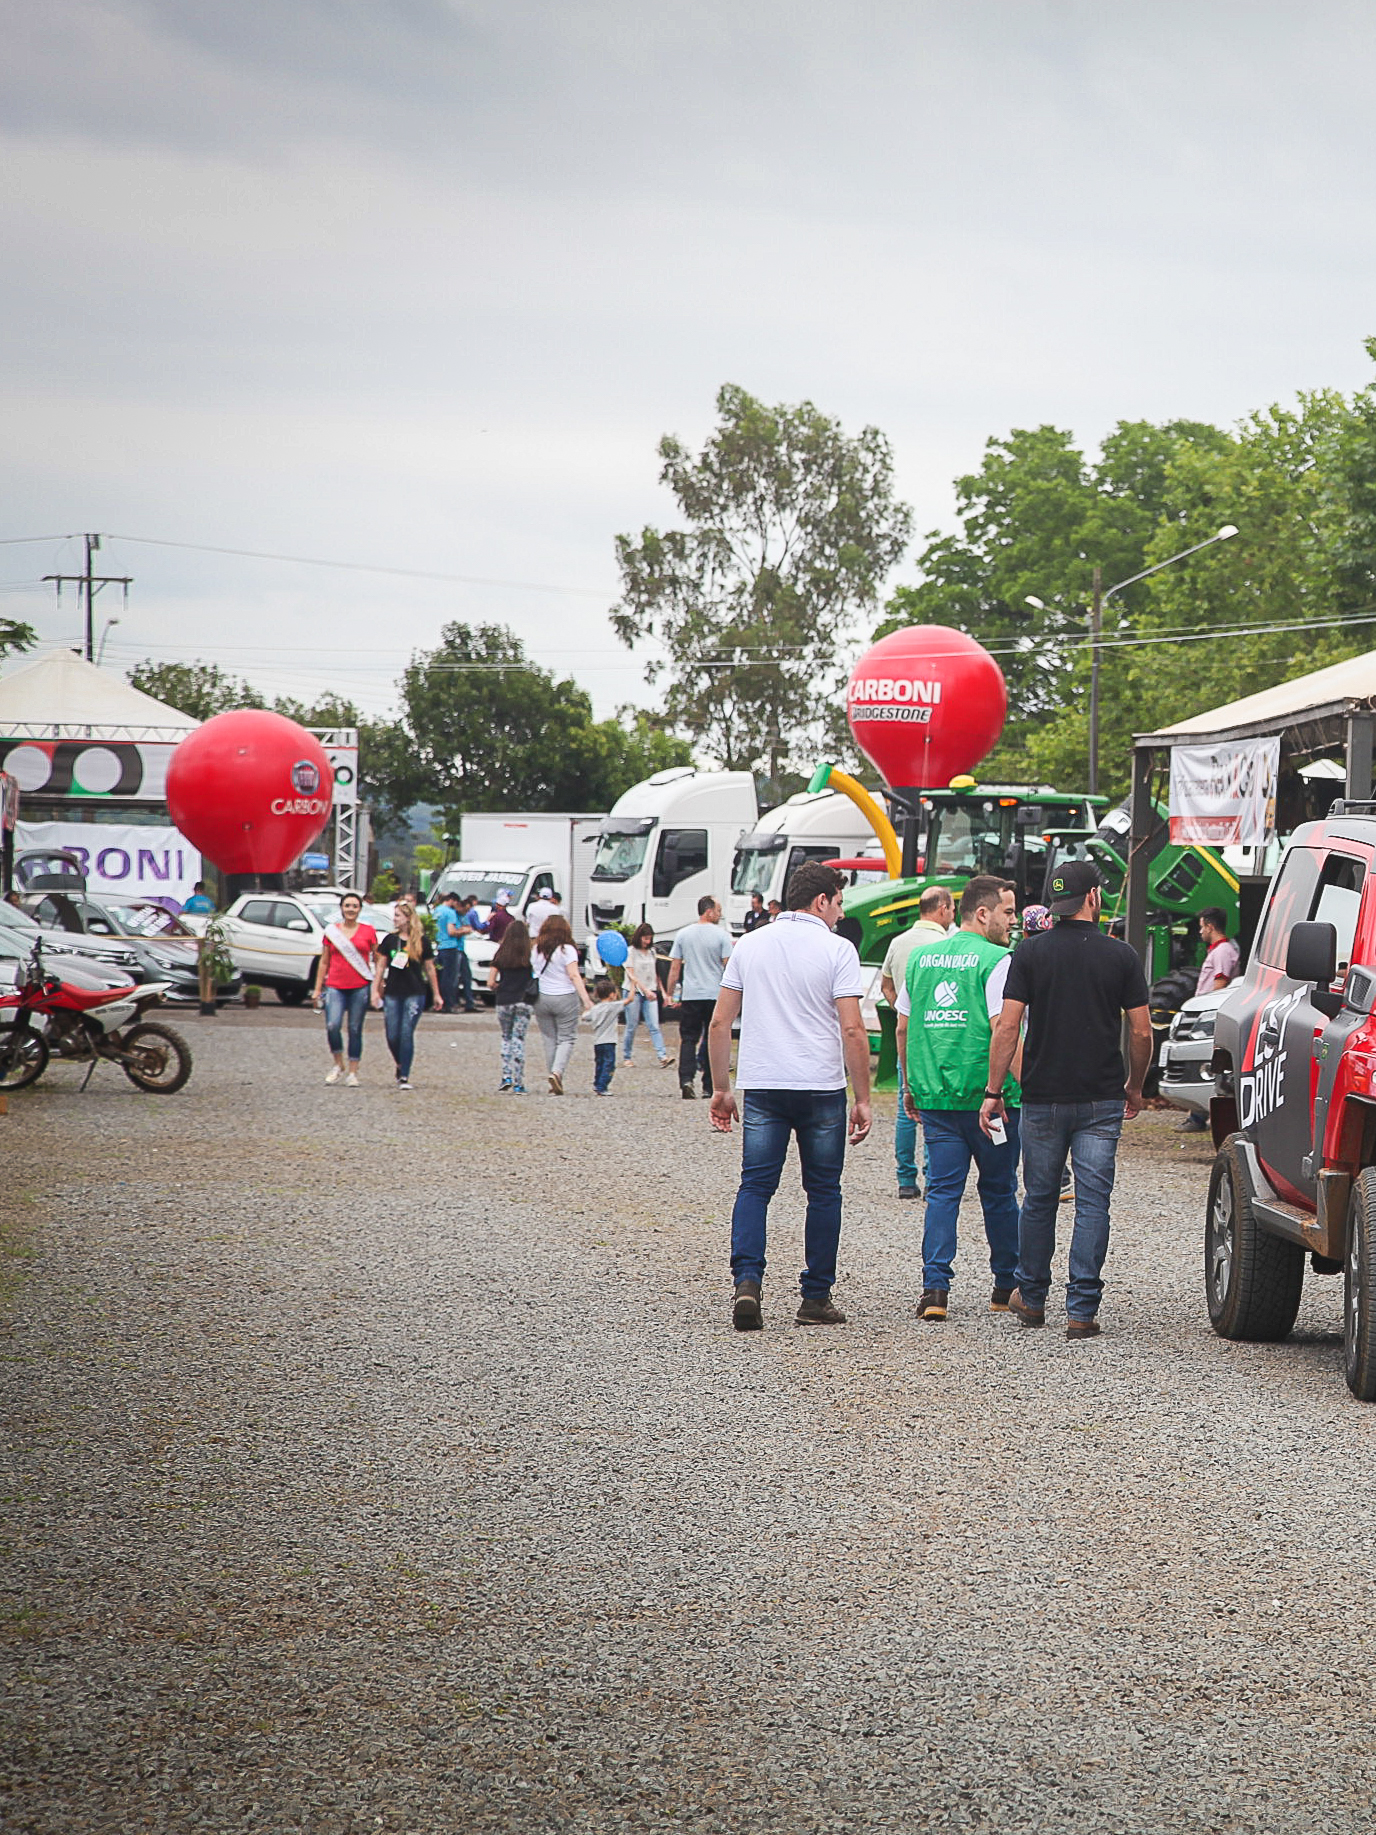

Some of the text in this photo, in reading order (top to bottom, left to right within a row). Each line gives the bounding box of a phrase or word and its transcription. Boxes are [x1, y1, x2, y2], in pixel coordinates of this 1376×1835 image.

[848, 679, 942, 704] CARBONI
[924, 1009, 968, 1021] UNOESC
[1240, 1051, 1287, 1130] DRIVE
